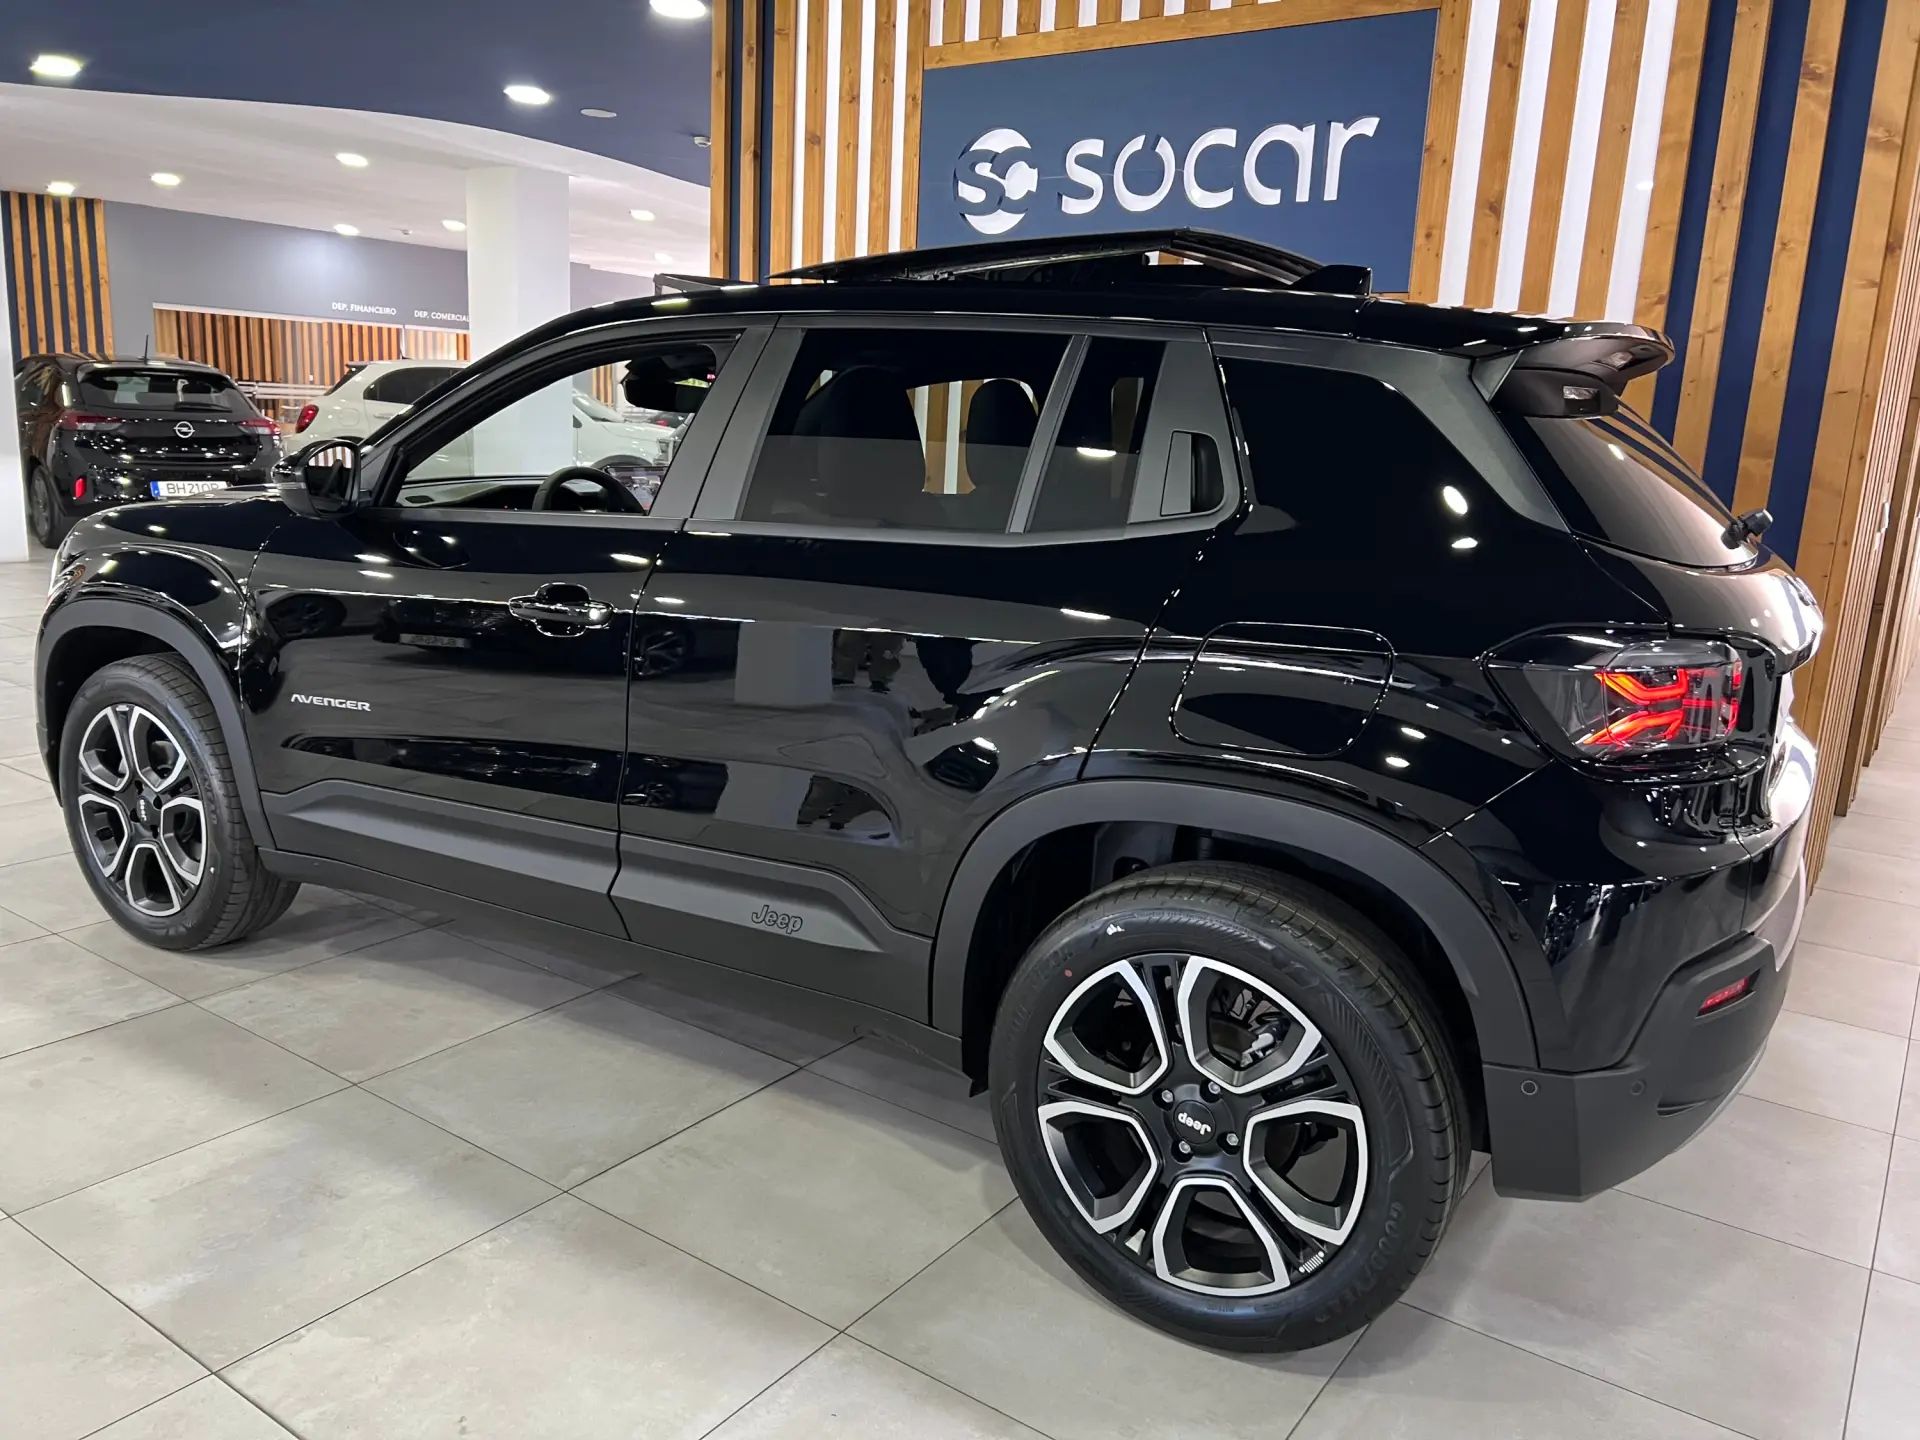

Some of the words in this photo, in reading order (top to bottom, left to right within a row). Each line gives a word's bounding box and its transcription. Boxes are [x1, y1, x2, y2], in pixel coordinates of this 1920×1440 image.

[1059, 116, 1380, 215] socar
[331, 301, 349, 312] DEP.
[350, 303, 398, 316] FINANCEIRO
[413, 309, 430, 319] DEP.
[290, 693, 372, 712] AVENGER
[751, 904, 804, 935] Jeep
[1177, 1112, 1212, 1136] Jeep
